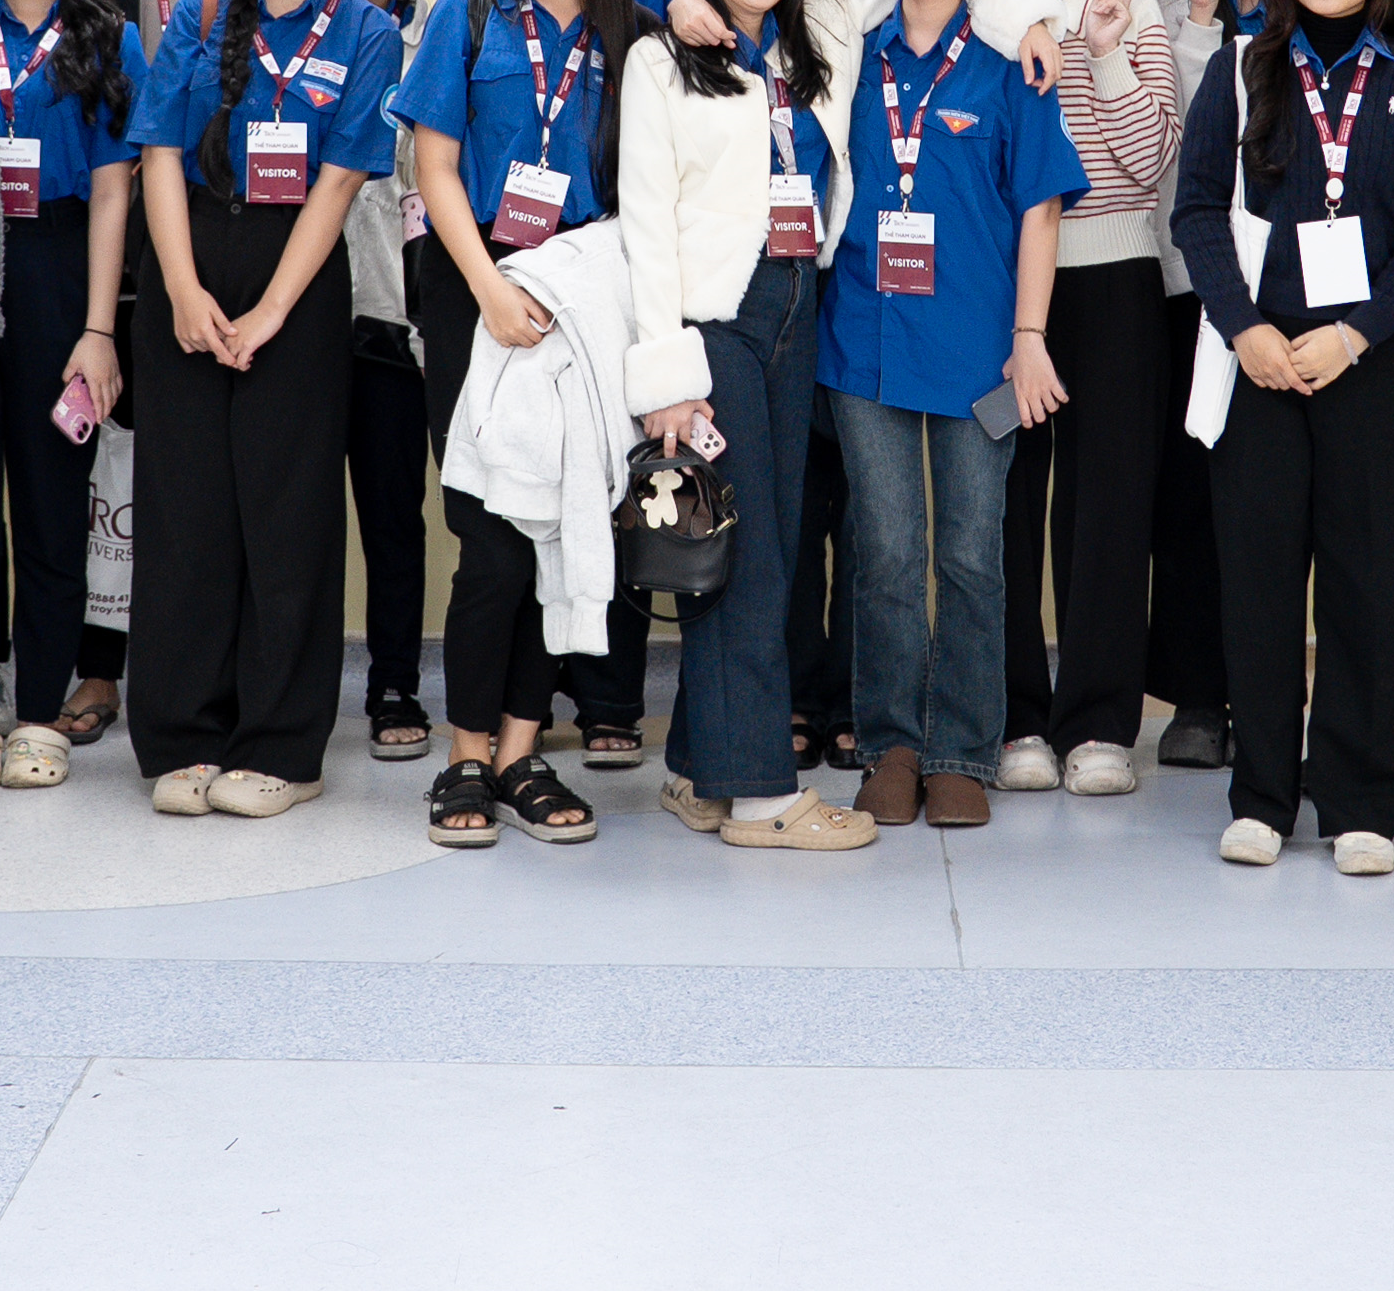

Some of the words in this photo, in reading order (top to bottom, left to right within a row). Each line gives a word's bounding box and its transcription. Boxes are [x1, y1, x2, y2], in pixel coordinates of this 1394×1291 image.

[257, 168, 297, 178] VISITOR
[1, 182, 30, 191] SITOR
[508, 209, 547, 228] VISITOR
[774, 222, 807, 232] VISITOR
[887, 257, 925, 269] VISITOR
[89, 482, 133, 540] RO
